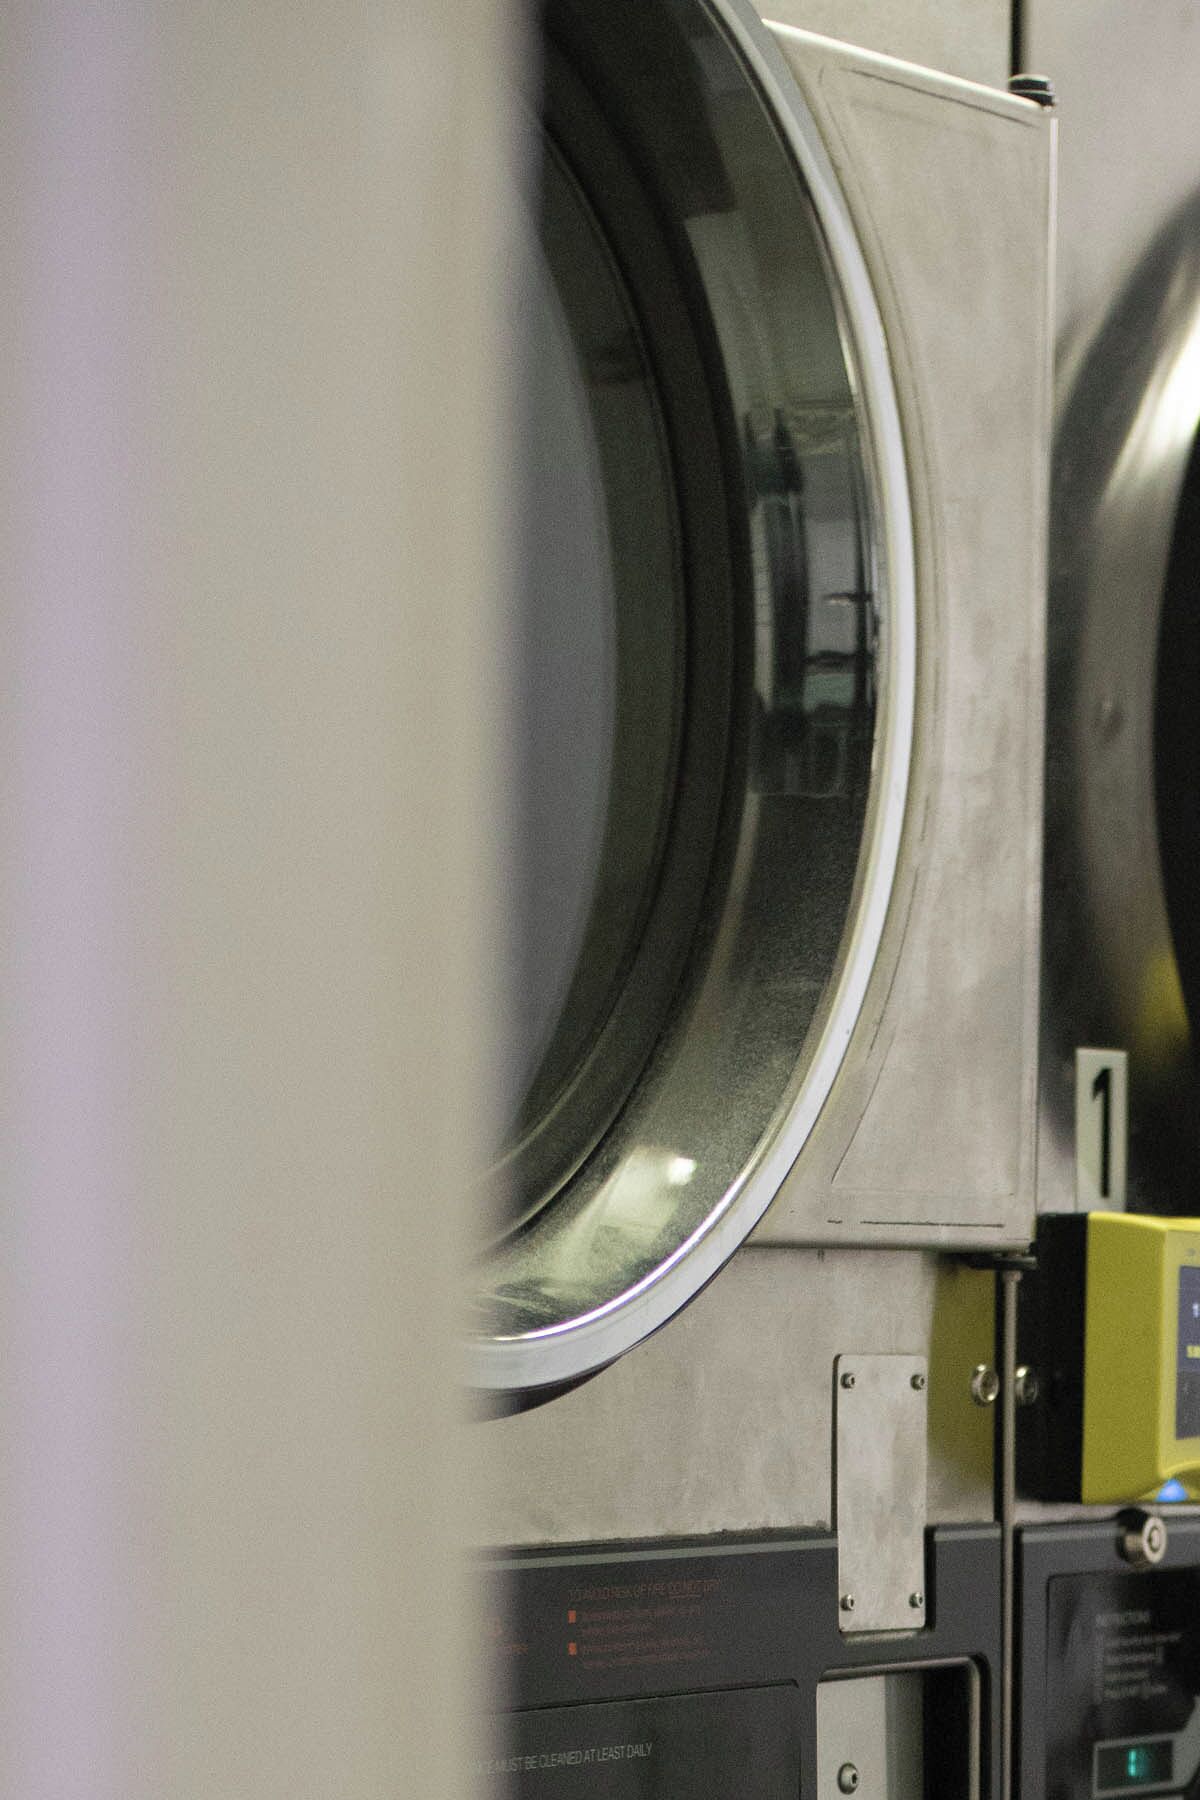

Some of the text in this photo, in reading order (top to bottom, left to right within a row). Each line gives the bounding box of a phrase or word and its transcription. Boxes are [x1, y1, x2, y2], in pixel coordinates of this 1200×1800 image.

[1092, 1066, 1112, 1198] 1
[1192, 1302, 1200, 1318] 1
[525, 1755, 537, 1770] BE
[539, 1751, 582, 1768] CLEANED
[584, 1748, 596, 1763] AT
[597, 1745, 625, 1762] LEAST
[626, 1742, 653, 1758] DAILY
